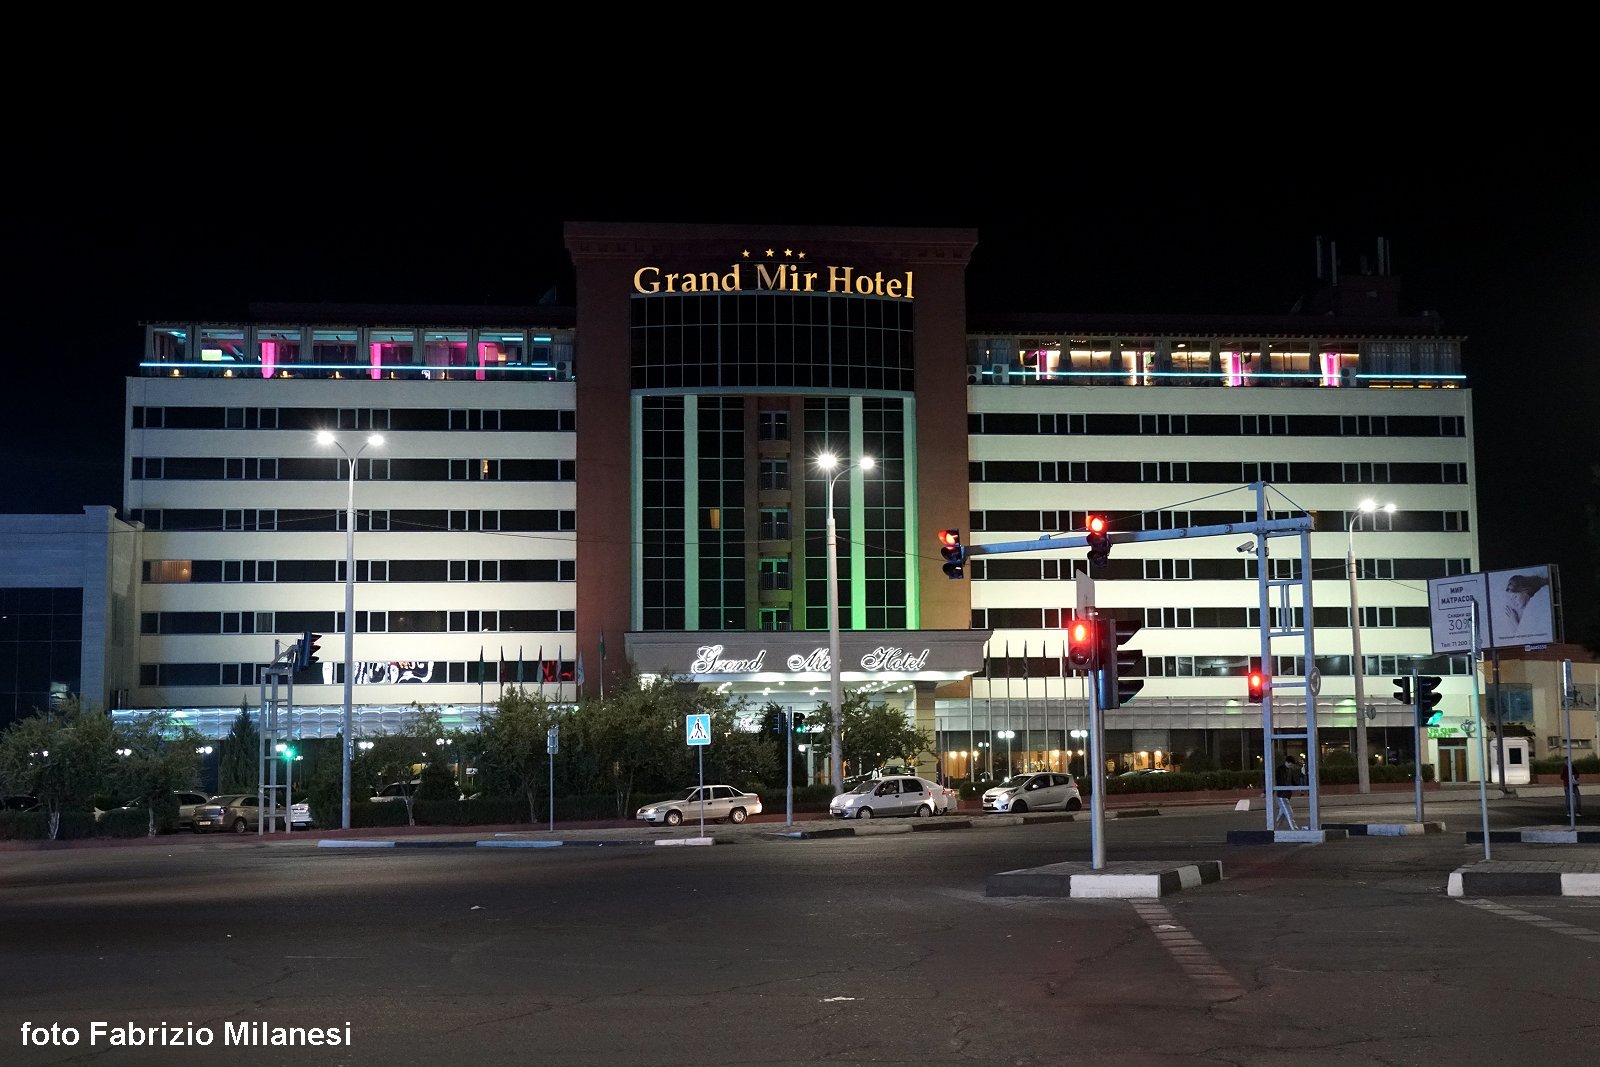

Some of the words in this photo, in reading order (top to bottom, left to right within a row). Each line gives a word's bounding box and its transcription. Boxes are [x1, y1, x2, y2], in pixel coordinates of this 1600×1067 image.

[633, 263, 743, 295] Grand
[755, 263, 818, 292] Mir
[827, 265, 915, 299] Hotel
[1441, 595, 1474, 605] МАТРАСОВ
[1450, 586, 1464, 595] МИР
[691, 645, 767, 674] Grand
[787, 647, 841, 672] Mi
[861, 645, 931, 672] Hotel
